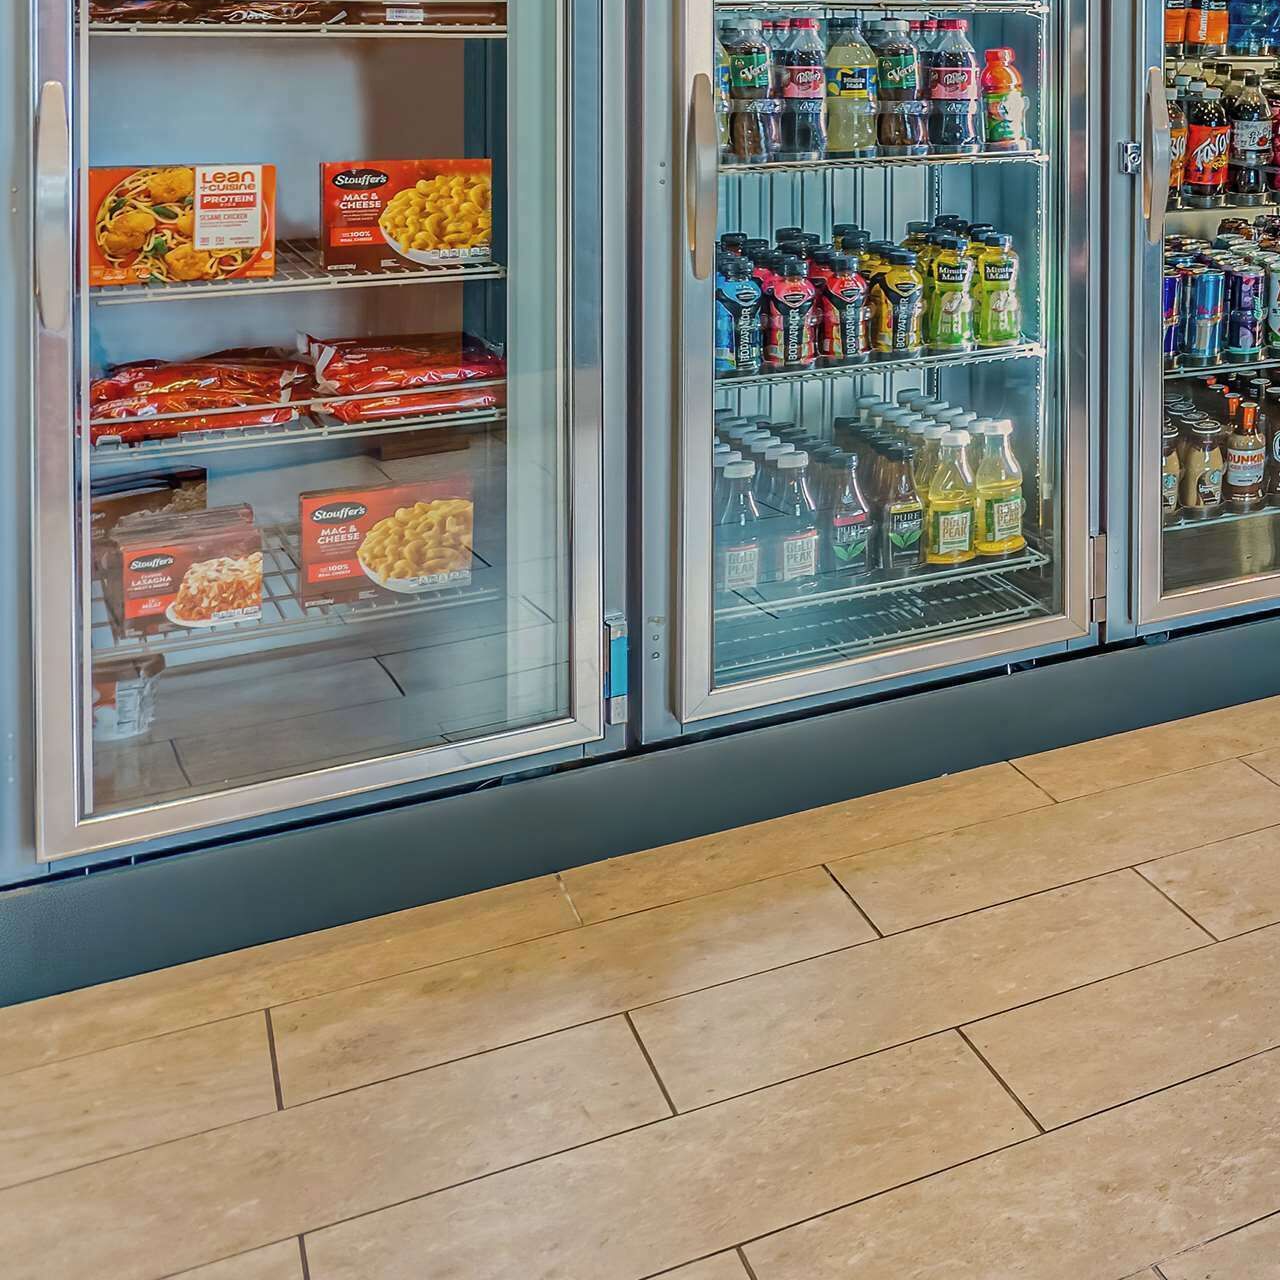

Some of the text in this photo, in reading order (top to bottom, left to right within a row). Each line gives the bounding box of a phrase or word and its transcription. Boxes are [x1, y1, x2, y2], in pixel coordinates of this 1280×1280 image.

[335, 173, 388, 189] Stouffer's
[203, 195, 254, 203] PROTEIN
[343, 193, 368, 201] MAC
[339, 201, 382, 209] CHEESE
[313, 506, 367, 521] Stouffer's
[320, 525, 357, 536] MAC &
[317, 532, 361, 544] CHEESE
[130, 555, 174, 569] Stouffer's
